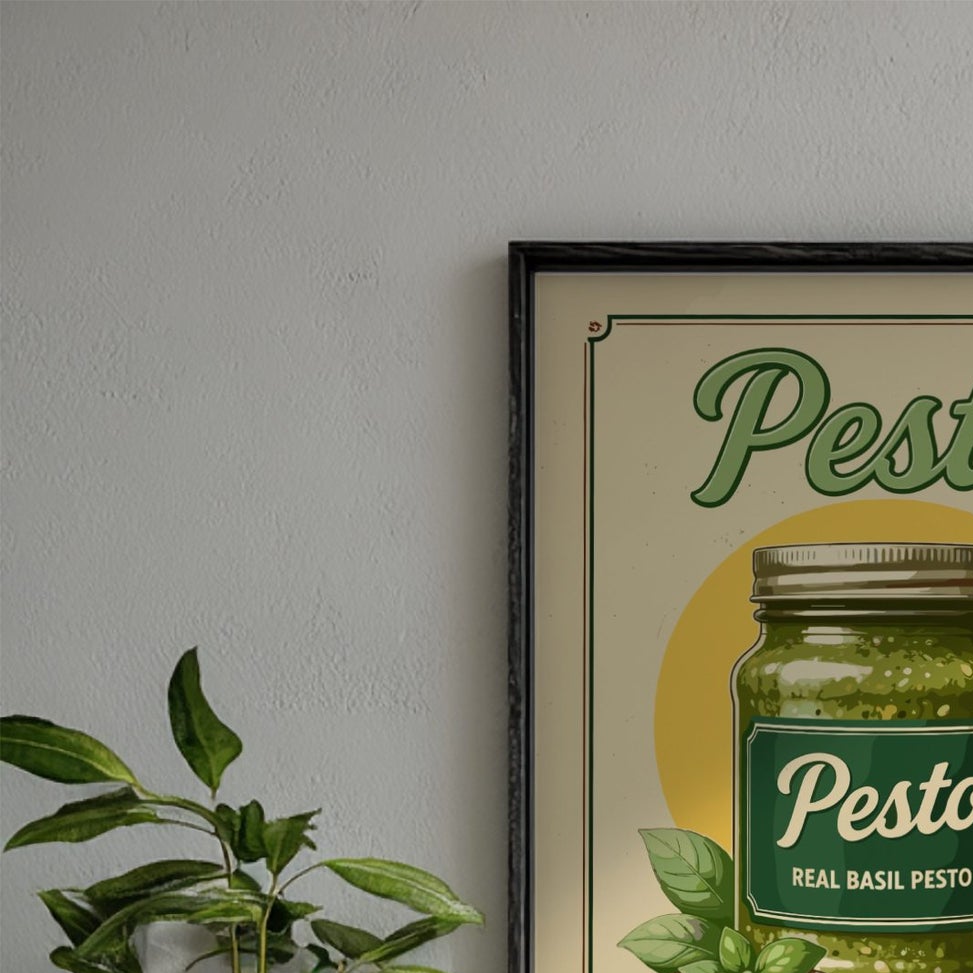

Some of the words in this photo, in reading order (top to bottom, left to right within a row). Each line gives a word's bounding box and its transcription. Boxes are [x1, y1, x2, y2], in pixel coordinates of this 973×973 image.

[792, 866, 841, 889] REAL
[846, 869, 905, 891] BASIL
[911, 867, 973, 889] PESTO
